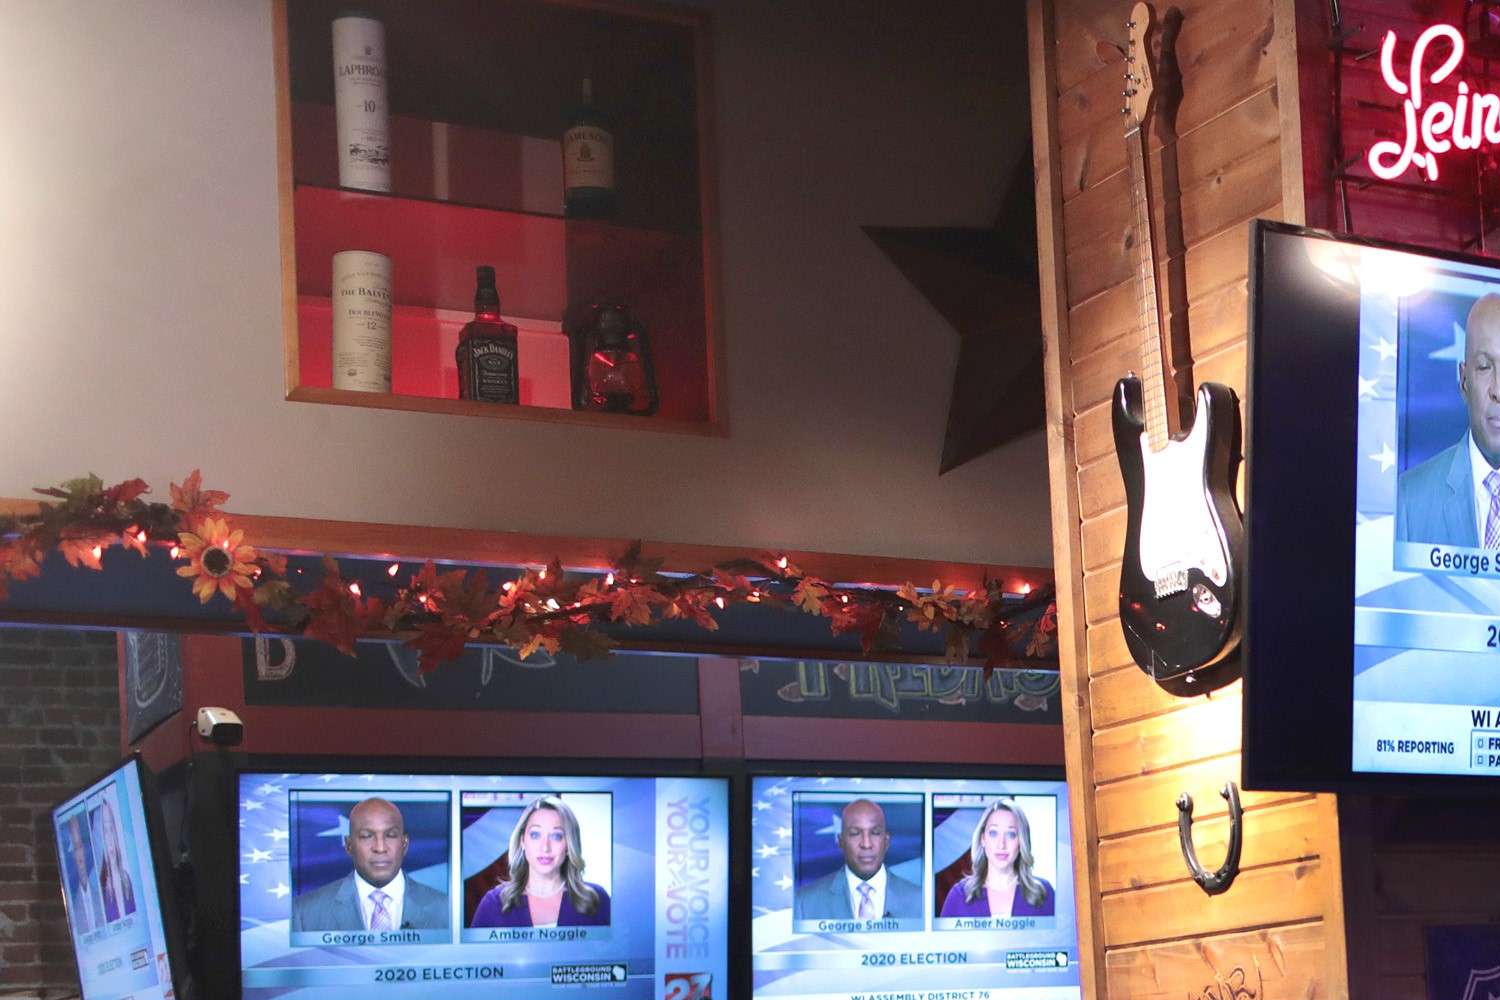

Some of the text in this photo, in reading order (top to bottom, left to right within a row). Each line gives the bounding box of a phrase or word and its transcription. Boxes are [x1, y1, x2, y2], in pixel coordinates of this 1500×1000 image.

[364, 101, 376, 112] 10
[1430, 548, 1489, 574] George
[1471, 710, 1491, 728] WI
[1376, 739, 1455, 754] 81% REPORTING
[818, 919, 899, 932] George Smith
[955, 917, 1036, 929] Amber Noggle
[322, 930, 421, 945] George Smith
[489, 927, 588, 941] Amber Noggle
[861, 952, 967, 966] 2020 ELECTION
[374, 966, 504, 982] 2020 ELECTION
[552, 973, 612, 983] WISCONSIN
[978, 991, 990, 1000] 76
